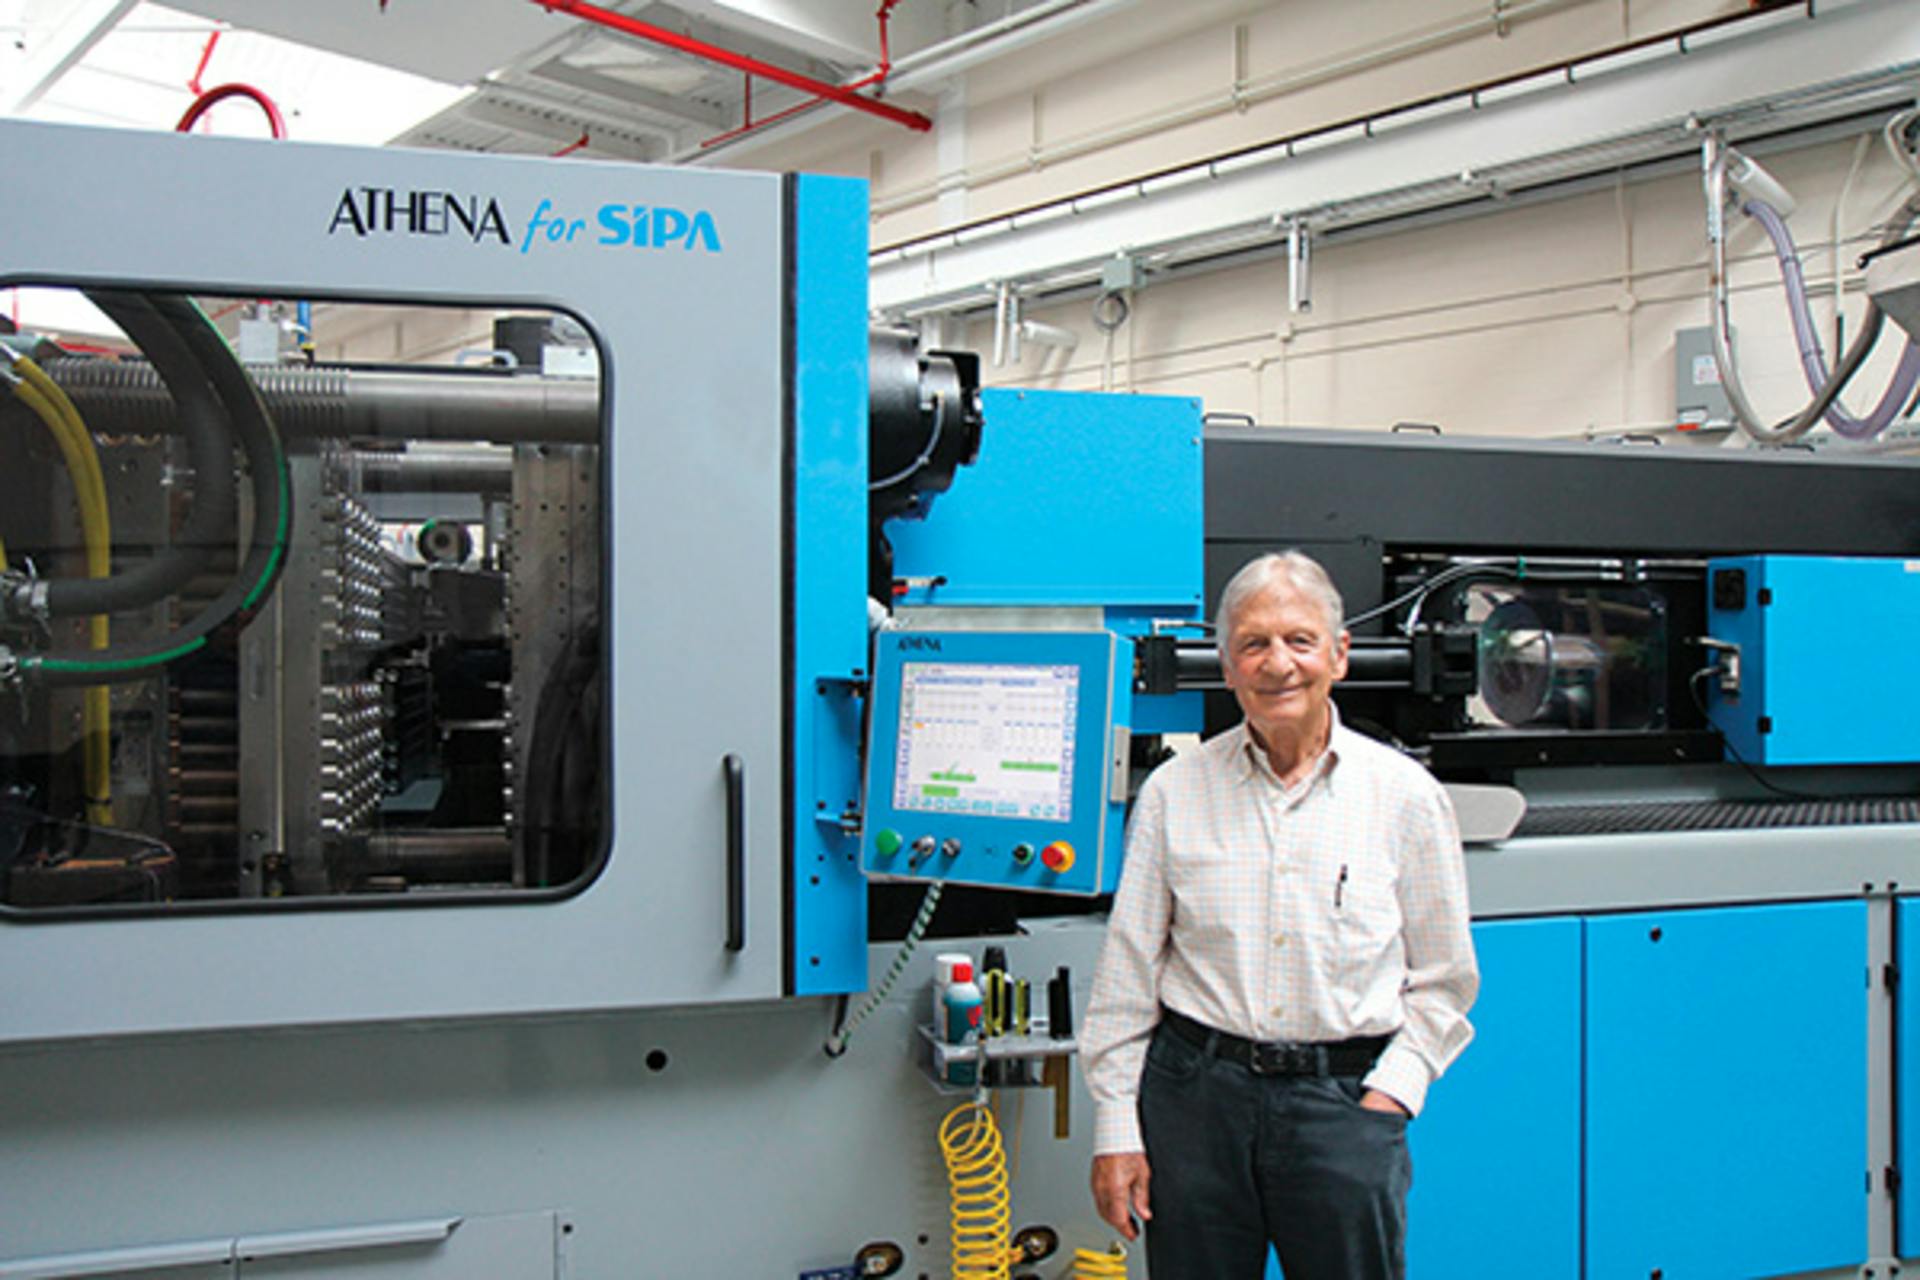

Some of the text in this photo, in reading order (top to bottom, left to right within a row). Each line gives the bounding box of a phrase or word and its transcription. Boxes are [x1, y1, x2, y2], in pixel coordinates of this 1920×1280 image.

[329, 187, 510, 244] ATHENA
[520, 199, 585, 253] for
[898, 636, 942, 652] ATHENA
